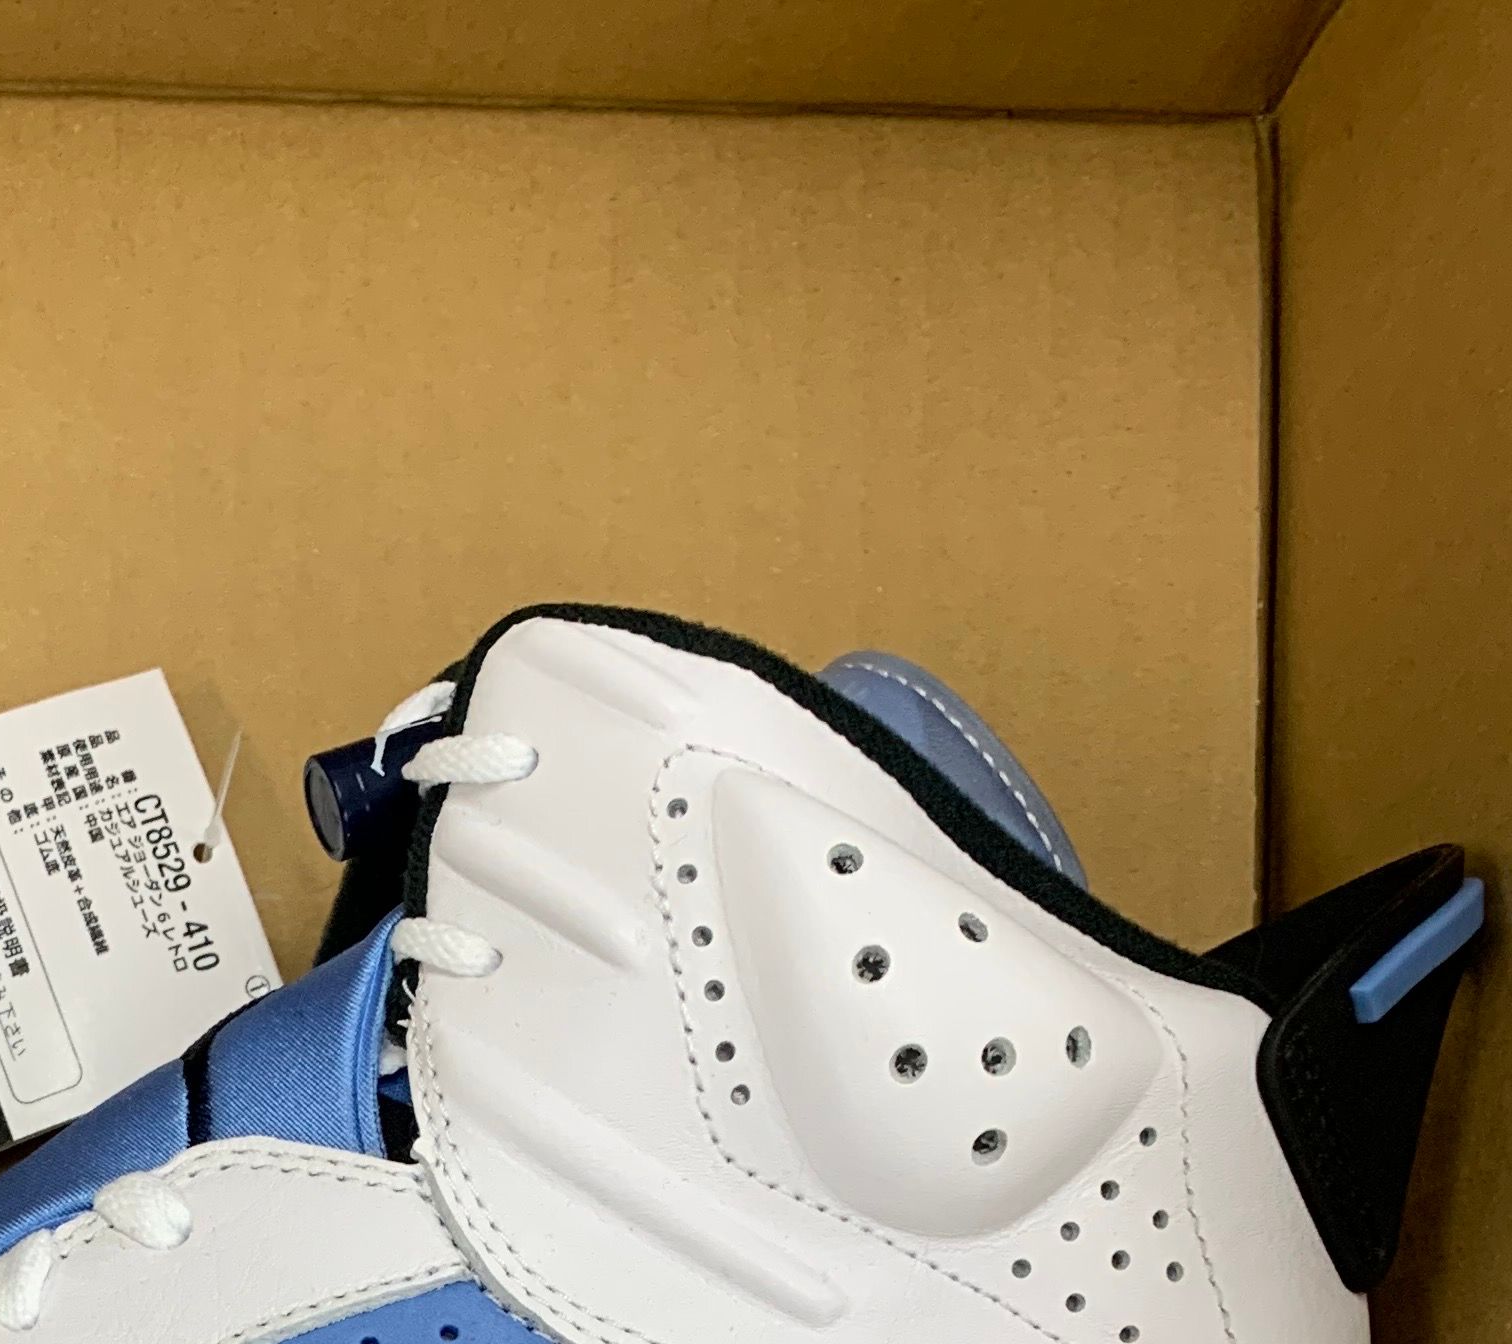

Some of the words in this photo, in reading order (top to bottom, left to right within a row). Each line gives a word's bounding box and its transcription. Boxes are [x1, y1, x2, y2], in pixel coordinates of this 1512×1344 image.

[133, 794, 192, 893] CT8529
[182, 921, 221, 972] 410
[157, 912, 171, 924] 6
